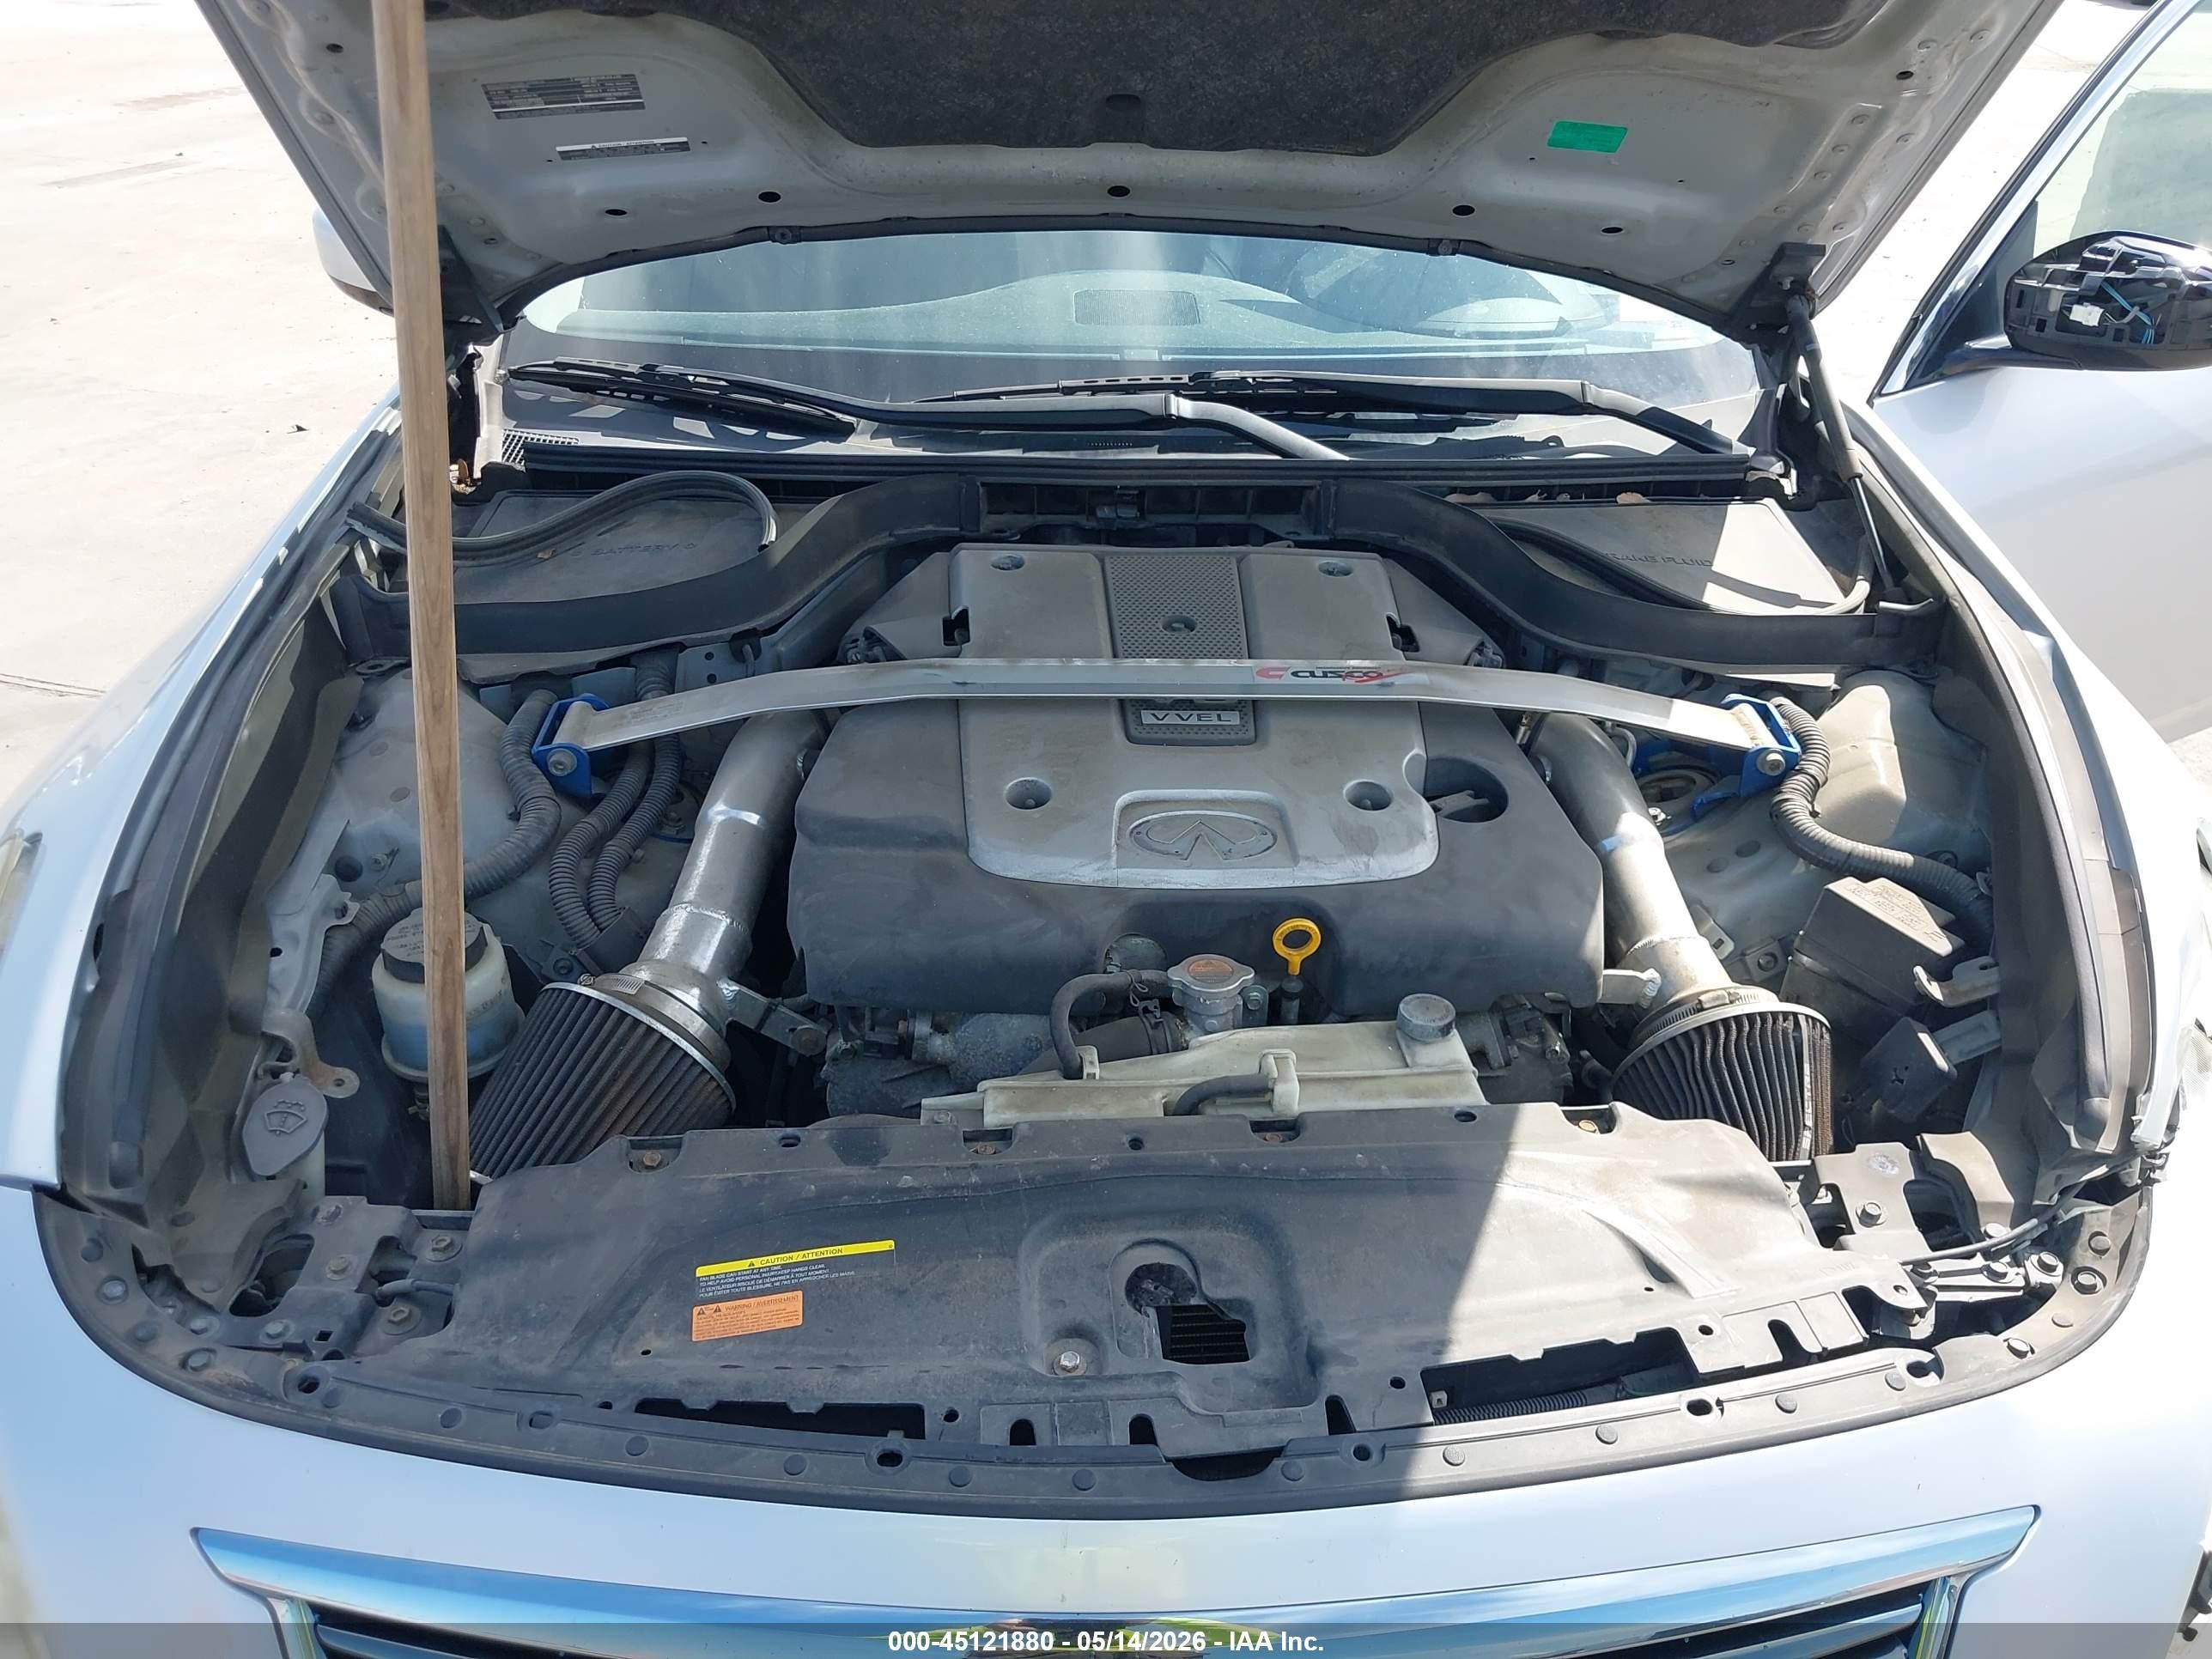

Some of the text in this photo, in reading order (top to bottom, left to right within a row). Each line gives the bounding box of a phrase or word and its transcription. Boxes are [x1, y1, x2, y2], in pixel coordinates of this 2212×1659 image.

[1150, 713, 1231, 722] VVEL
[760, 1255, 793, 1265] CAUTION
[801, 1249, 843, 1259] ATTENTION
